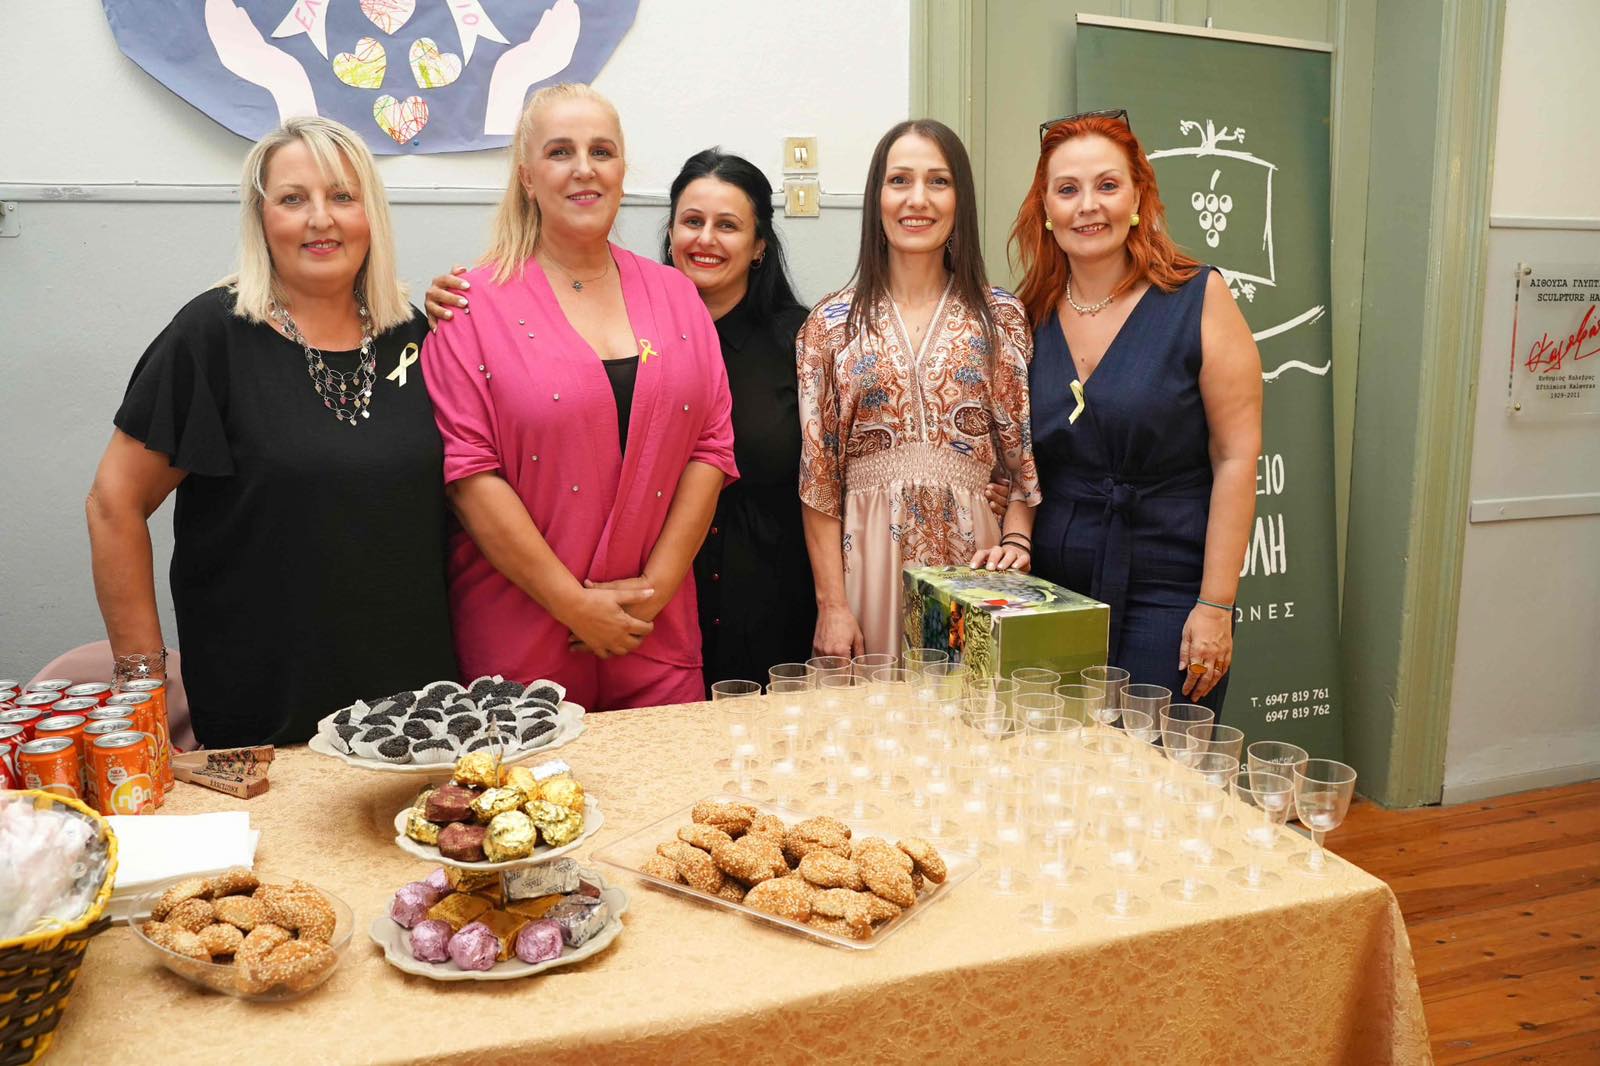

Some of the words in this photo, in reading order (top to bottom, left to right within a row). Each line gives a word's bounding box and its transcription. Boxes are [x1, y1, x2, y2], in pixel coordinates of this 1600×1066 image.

[1530, 278, 1568, 288] ΑΙΘΟΥΣΑ
[1573, 278, 1600, 288] ΓΛΥΠΤ
[1537, 293, 1585, 302] SCULPTURE
[1265, 693, 1289, 706] 6947
[1291, 690, 1310, 702] 819
[1312, 687, 1329, 700] 761
[1265, 709, 1289, 722] 6947
[1292, 706, 1310, 719] 819
[1312, 704, 1330, 716] 762
